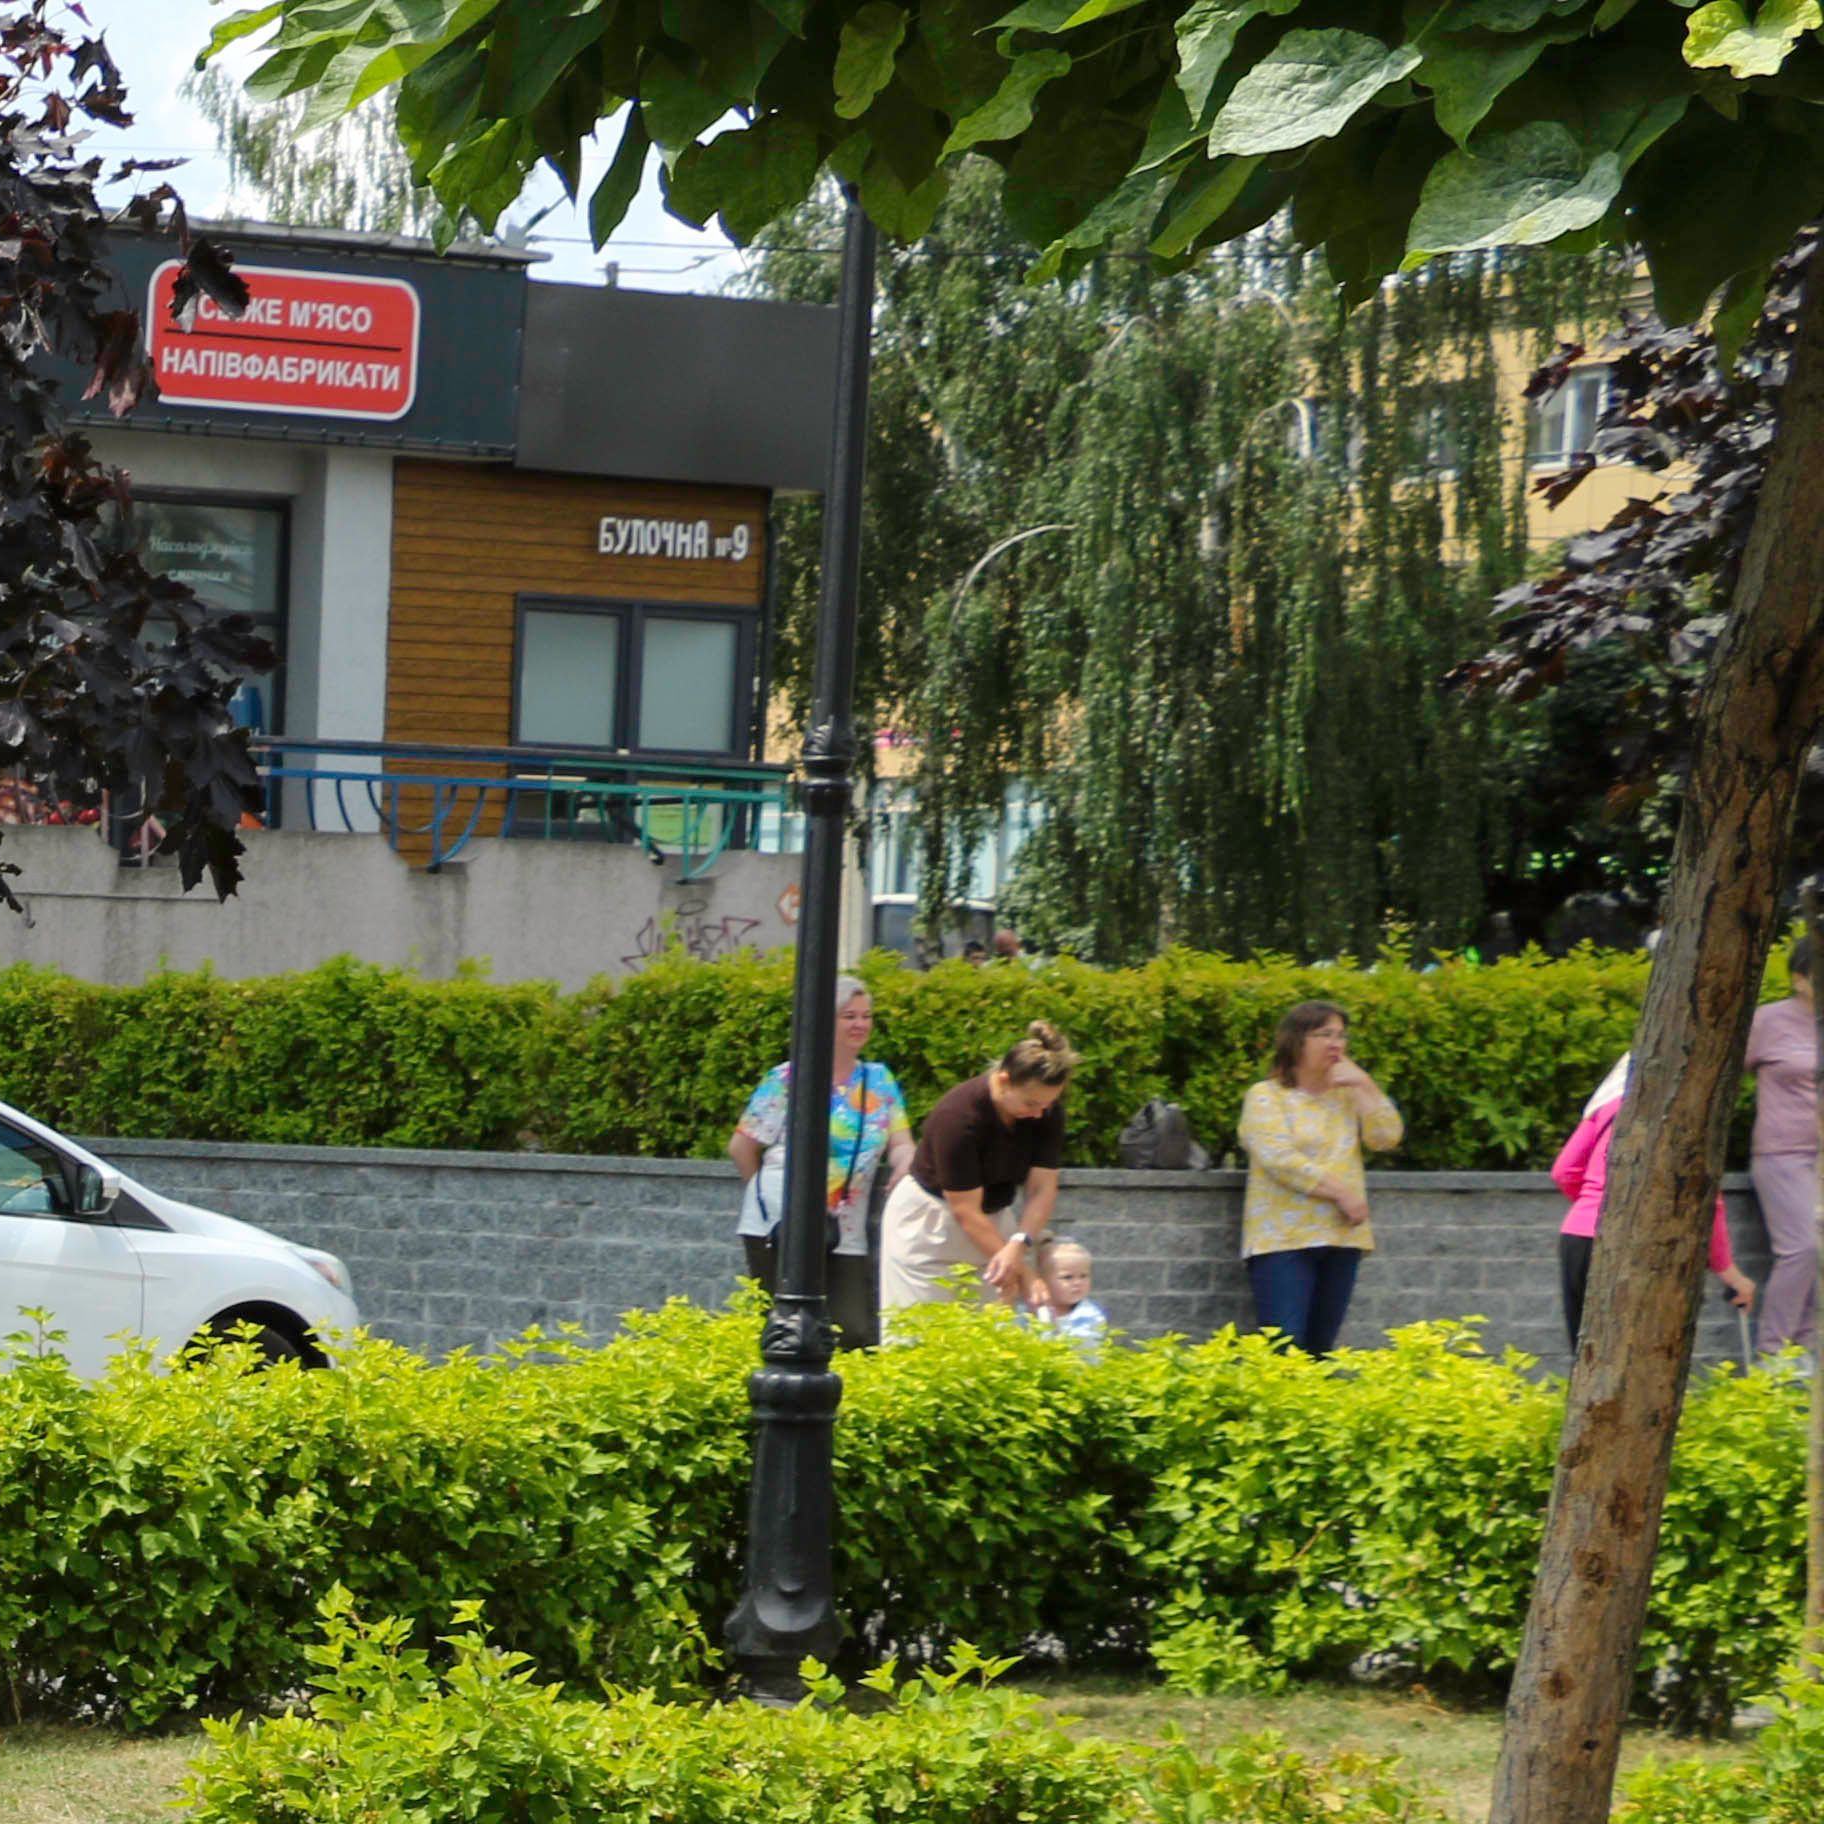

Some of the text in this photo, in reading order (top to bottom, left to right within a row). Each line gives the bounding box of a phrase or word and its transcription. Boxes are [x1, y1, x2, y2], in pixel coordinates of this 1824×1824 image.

[198, 295, 372, 333] СЖЕ М'ЯСО
[161, 346, 400, 391] НАПІВФАБРИКАТИ
[599, 516, 708, 558] БУЛОЧНА
